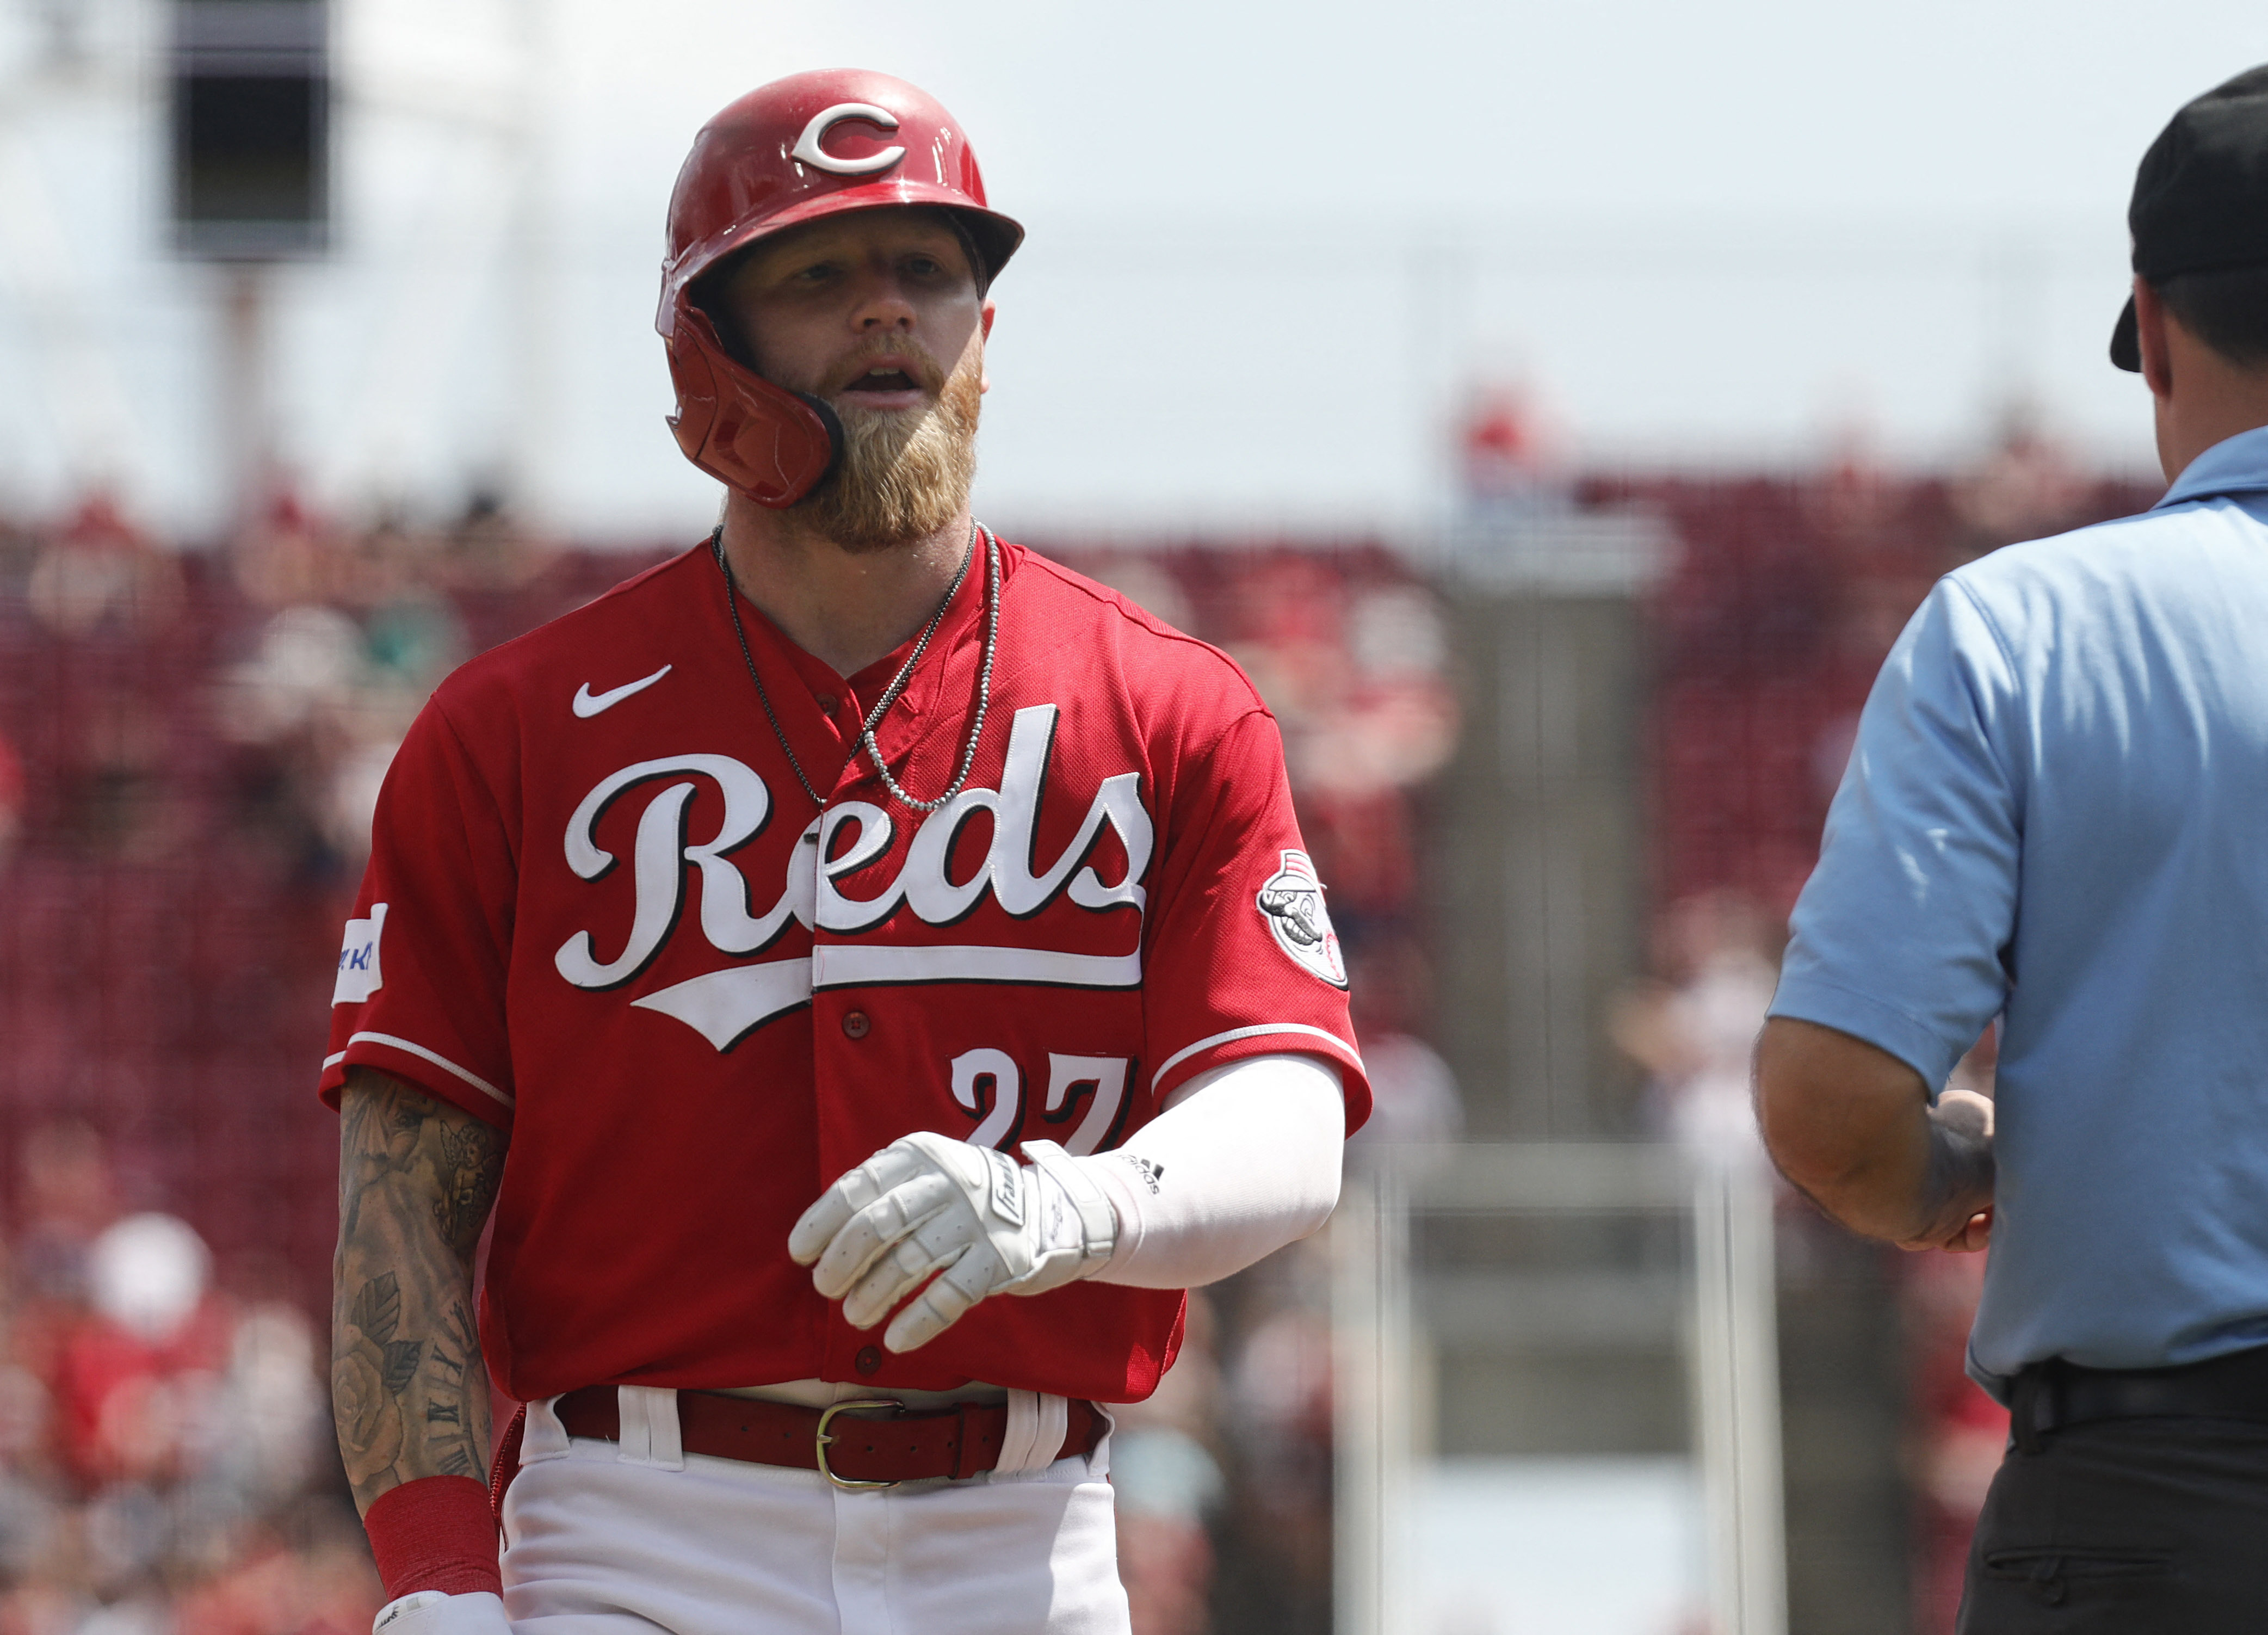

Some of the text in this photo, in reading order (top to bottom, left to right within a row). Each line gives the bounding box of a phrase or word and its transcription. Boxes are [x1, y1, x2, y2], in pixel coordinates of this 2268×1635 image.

[791, 102, 907, 177] C
[554, 703, 1154, 990] Reds
[949, 1047, 1138, 1153] 27
